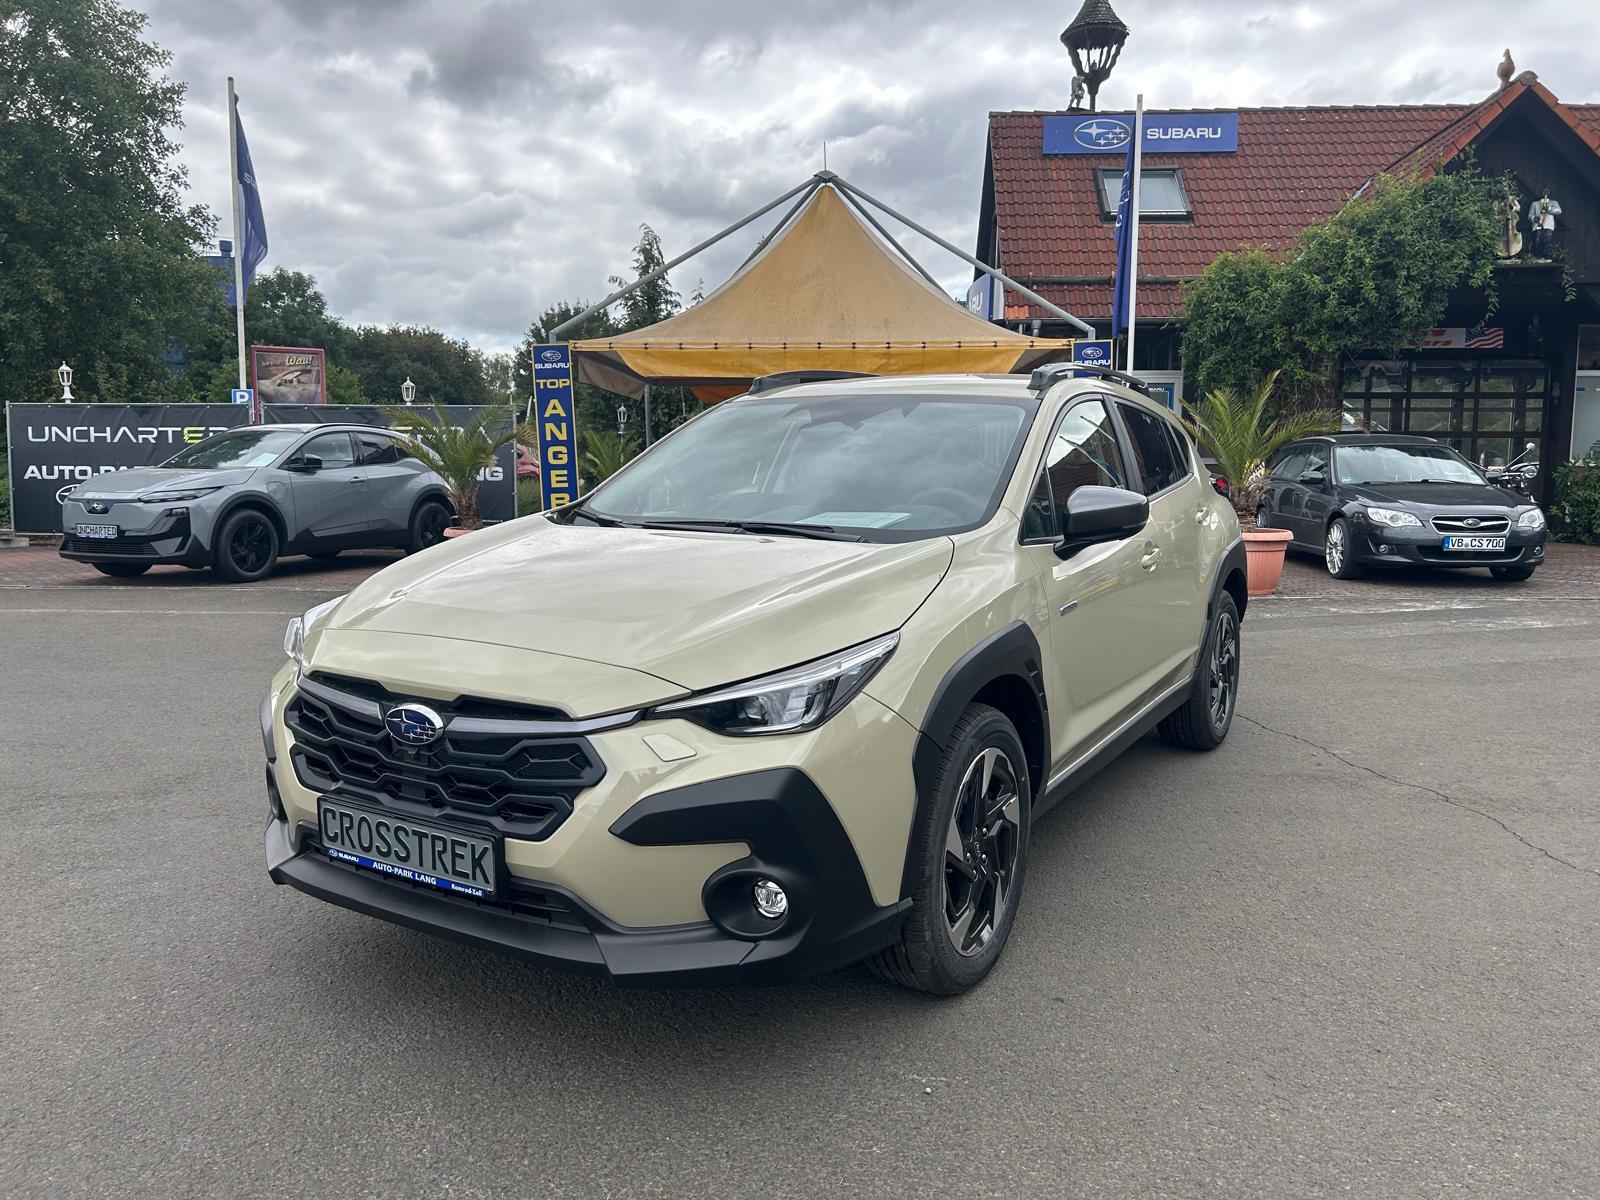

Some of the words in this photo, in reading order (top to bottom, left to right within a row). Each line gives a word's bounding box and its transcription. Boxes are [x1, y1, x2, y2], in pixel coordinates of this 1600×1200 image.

[1146, 127, 1222, 139] SUBARU
[536, 378, 571, 389] TOP
[1451, 538, 1464, 548] VB
[1470, 538, 1484, 548] CS
[1485, 538, 1505, 548] 700
[322, 807, 491, 885] CROSSTREK
[338, 852, 359, 863] SUBARU
[372, 861, 413, 879] AUTO-PARK
[415, 872, 437, 885] LANG
